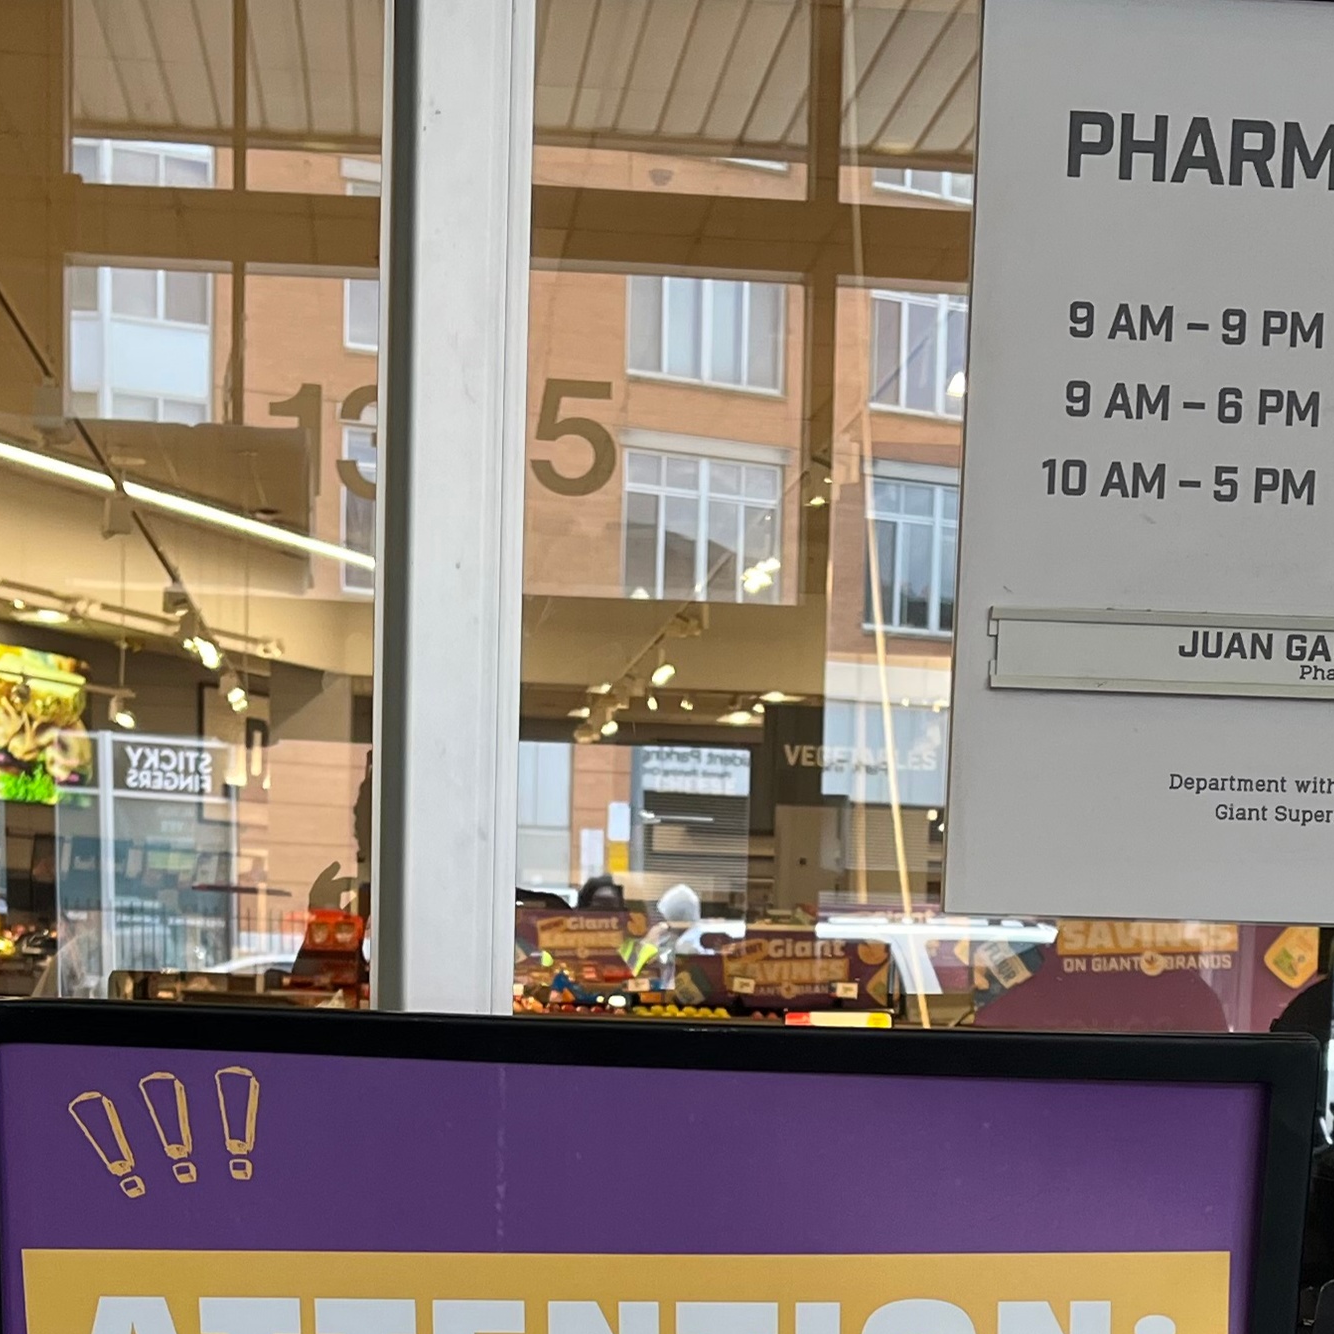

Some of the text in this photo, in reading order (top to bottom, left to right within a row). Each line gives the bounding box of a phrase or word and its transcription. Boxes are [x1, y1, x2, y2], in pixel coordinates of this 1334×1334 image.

[1070, 301, 1094, 338] 9
[1108, 304, 1173, 342] AM
[1222, 309, 1246, 345] 9
[1262, 311, 1323, 348] PM
[1066, 381, 1090, 417] 9
[1104, 383, 1170, 420] AM
[1218, 388, 1242, 423] 6
[1258, 389, 1319, 427] PM
[1042, 459, 1086, 496] 10
[1100, 462, 1165, 499] AM
[1214, 466, 1238, 502] 5
[1254, 468, 1315, 505] PM
[1179, 631, 1273, 660] JUAN
[1169, 774, 1286, 794] Department
[1216, 804, 1267, 821] Giant
[768, 938, 847, 958] Giant
[1063, 921, 1230, 949] SAVINGS
[1063, 955, 1232, 973] ON GIANT BRANDS
